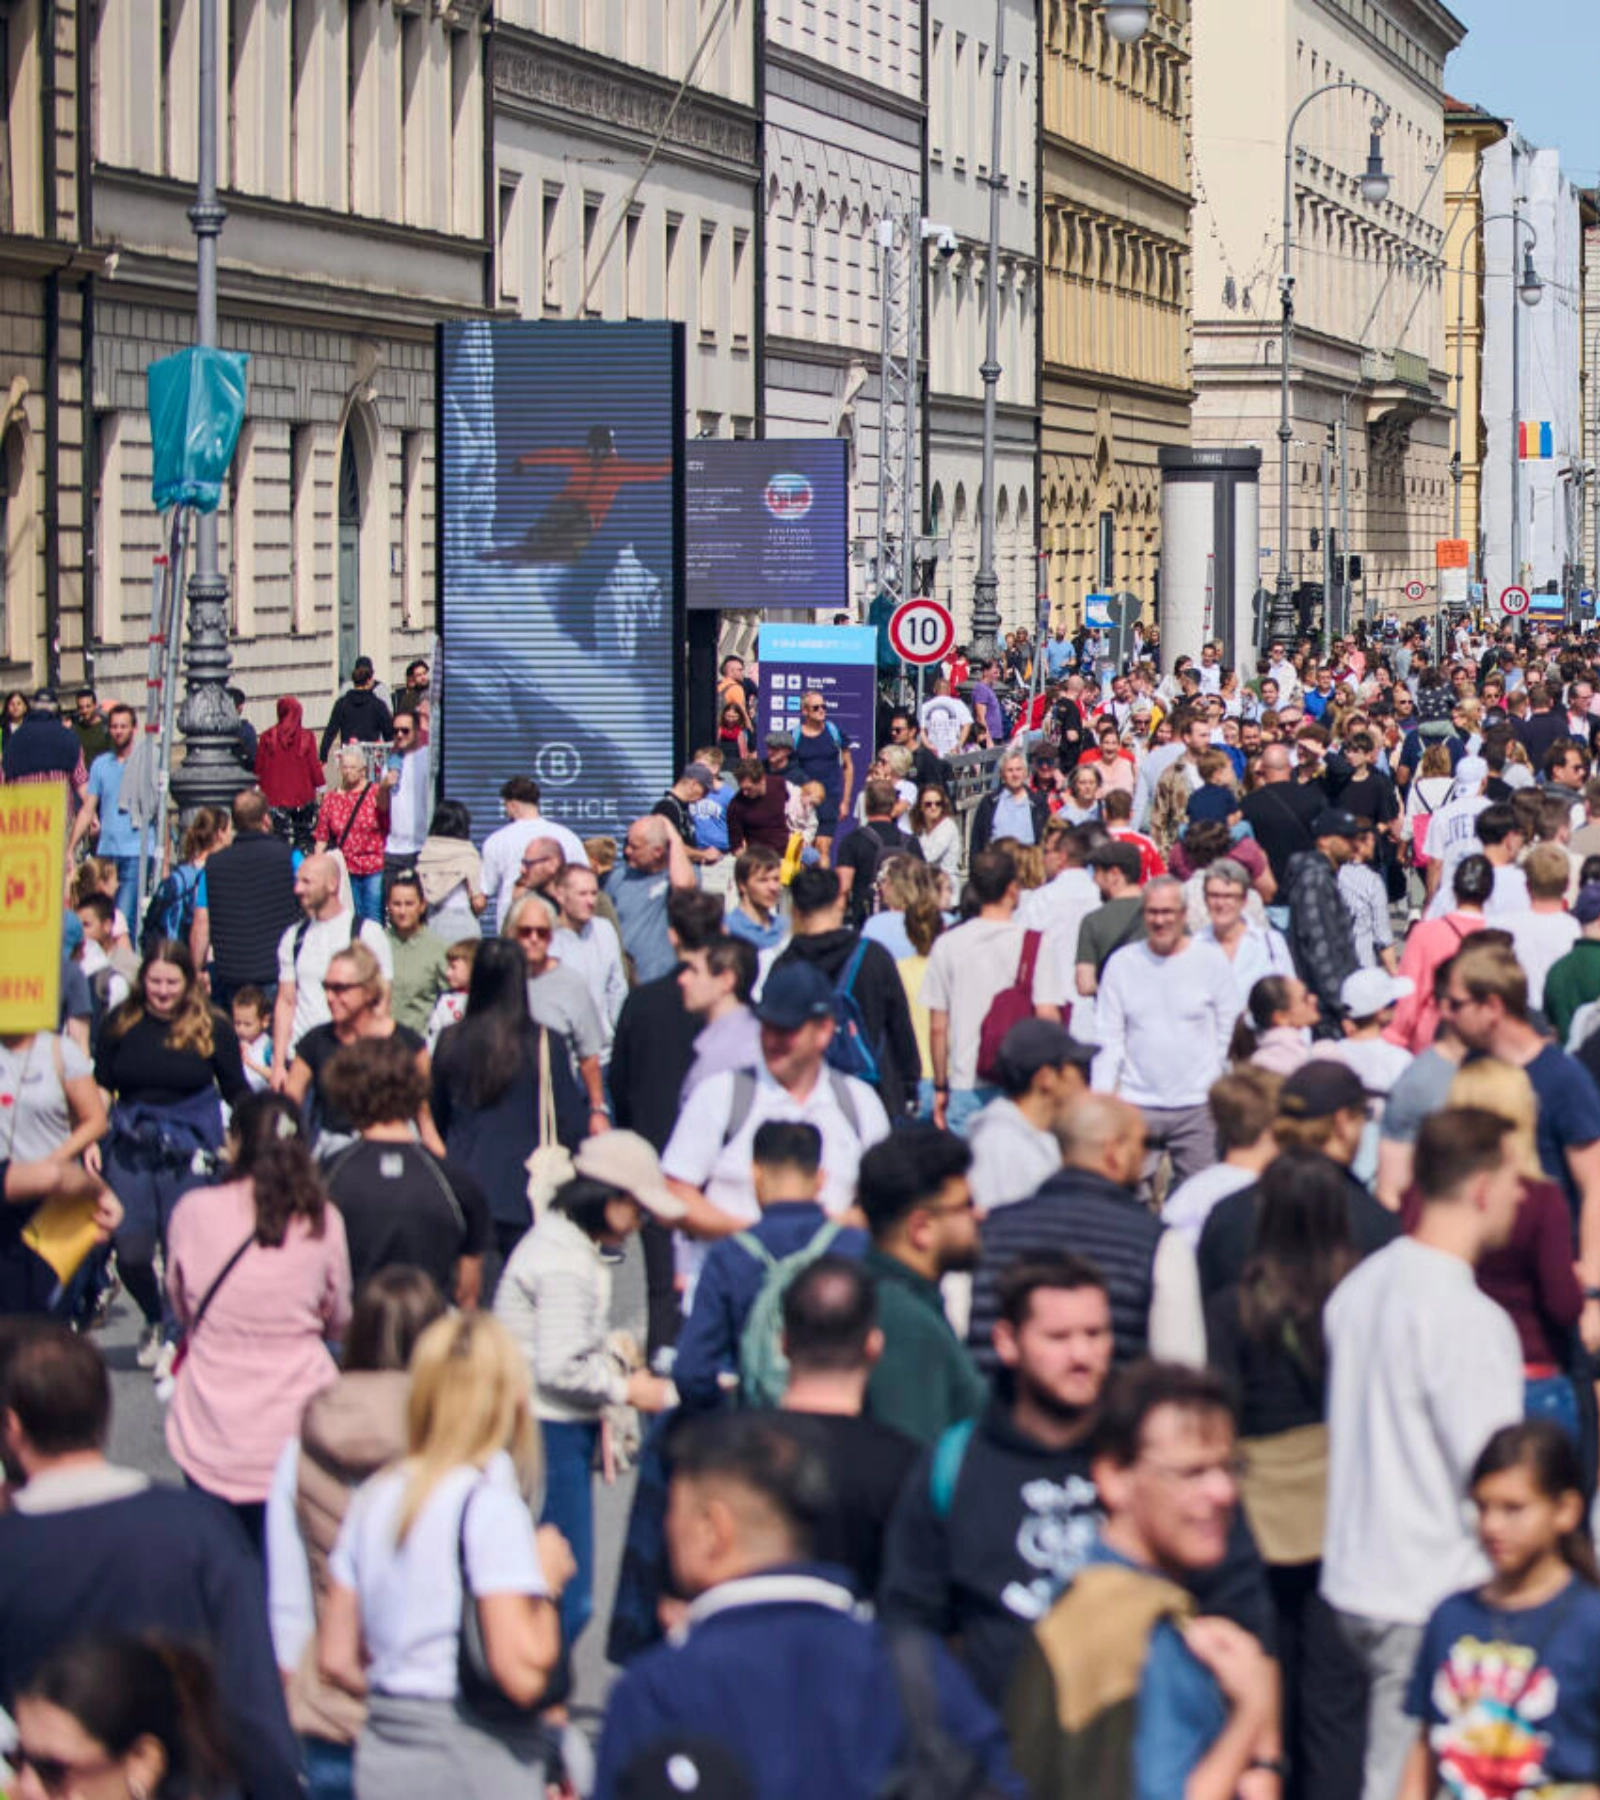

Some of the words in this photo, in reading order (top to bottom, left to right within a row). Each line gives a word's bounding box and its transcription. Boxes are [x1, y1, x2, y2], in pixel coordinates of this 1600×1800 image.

[1411, 588, 1420, 596] 10
[1508, 594, 1522, 608] 10
[907, 616, 938, 647] 10
